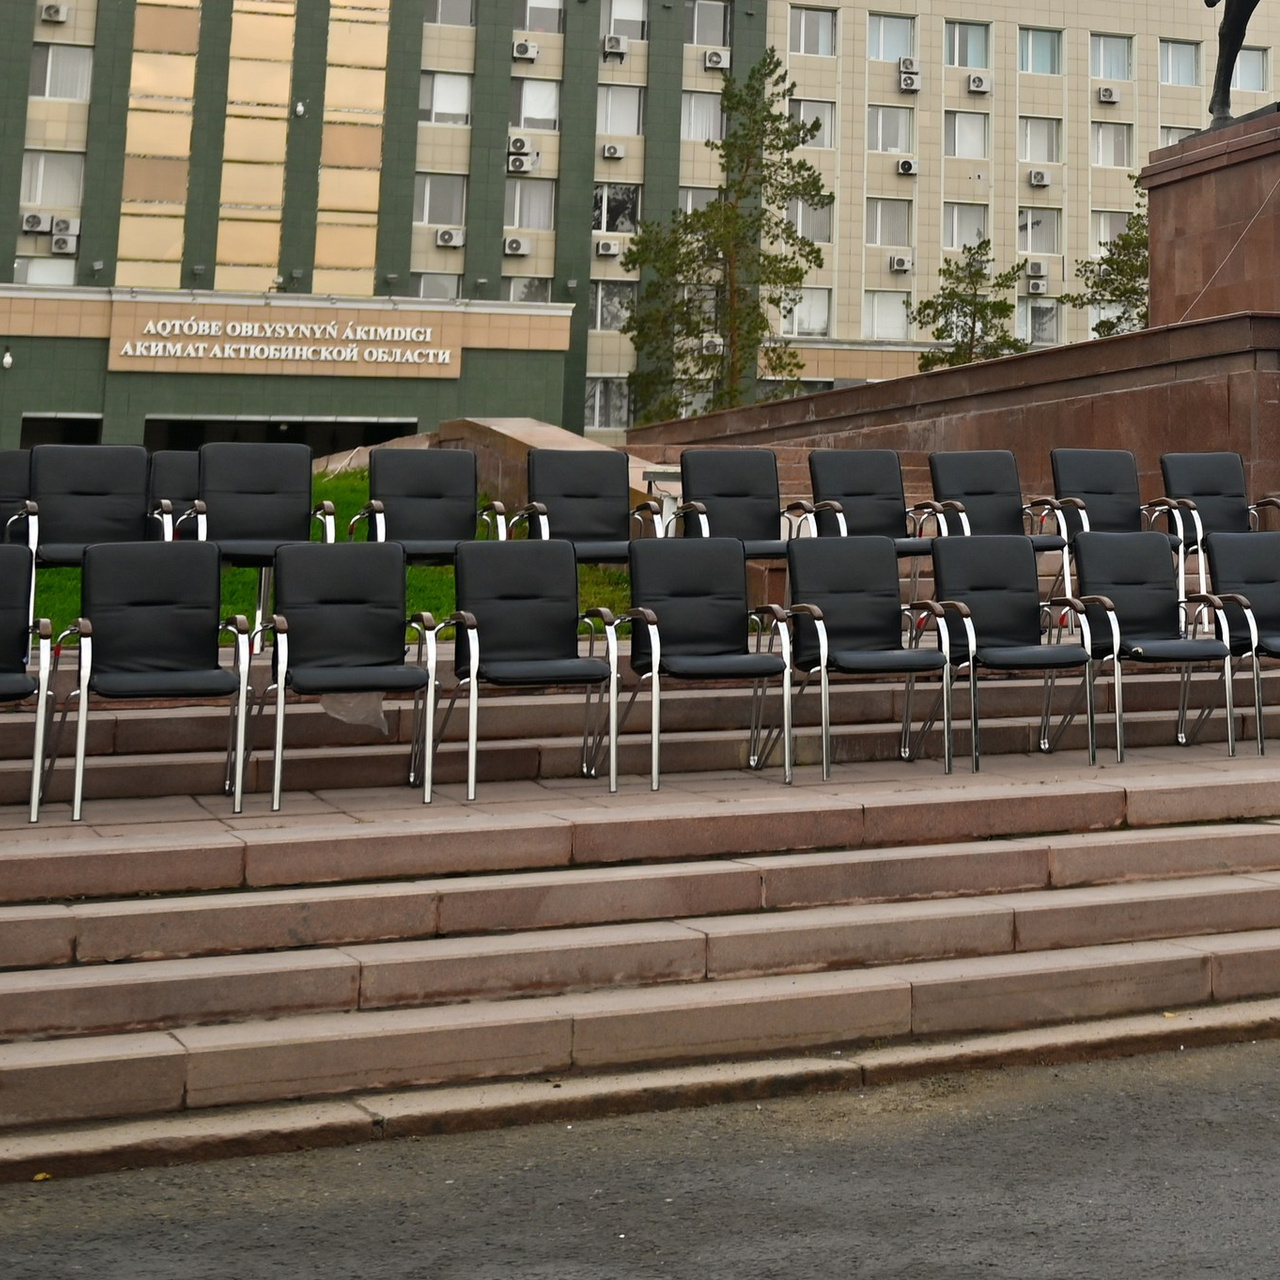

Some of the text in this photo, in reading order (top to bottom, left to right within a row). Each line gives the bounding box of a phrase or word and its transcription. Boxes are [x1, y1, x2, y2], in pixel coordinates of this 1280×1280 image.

[143, 316, 223, 338] AQTÓBE
[342, 321, 433, 342] ÁKIMDIGI
[119, 340, 452, 364] АКИМАТ АКТЮБИНСКОЙ ОБЛАСТИ
